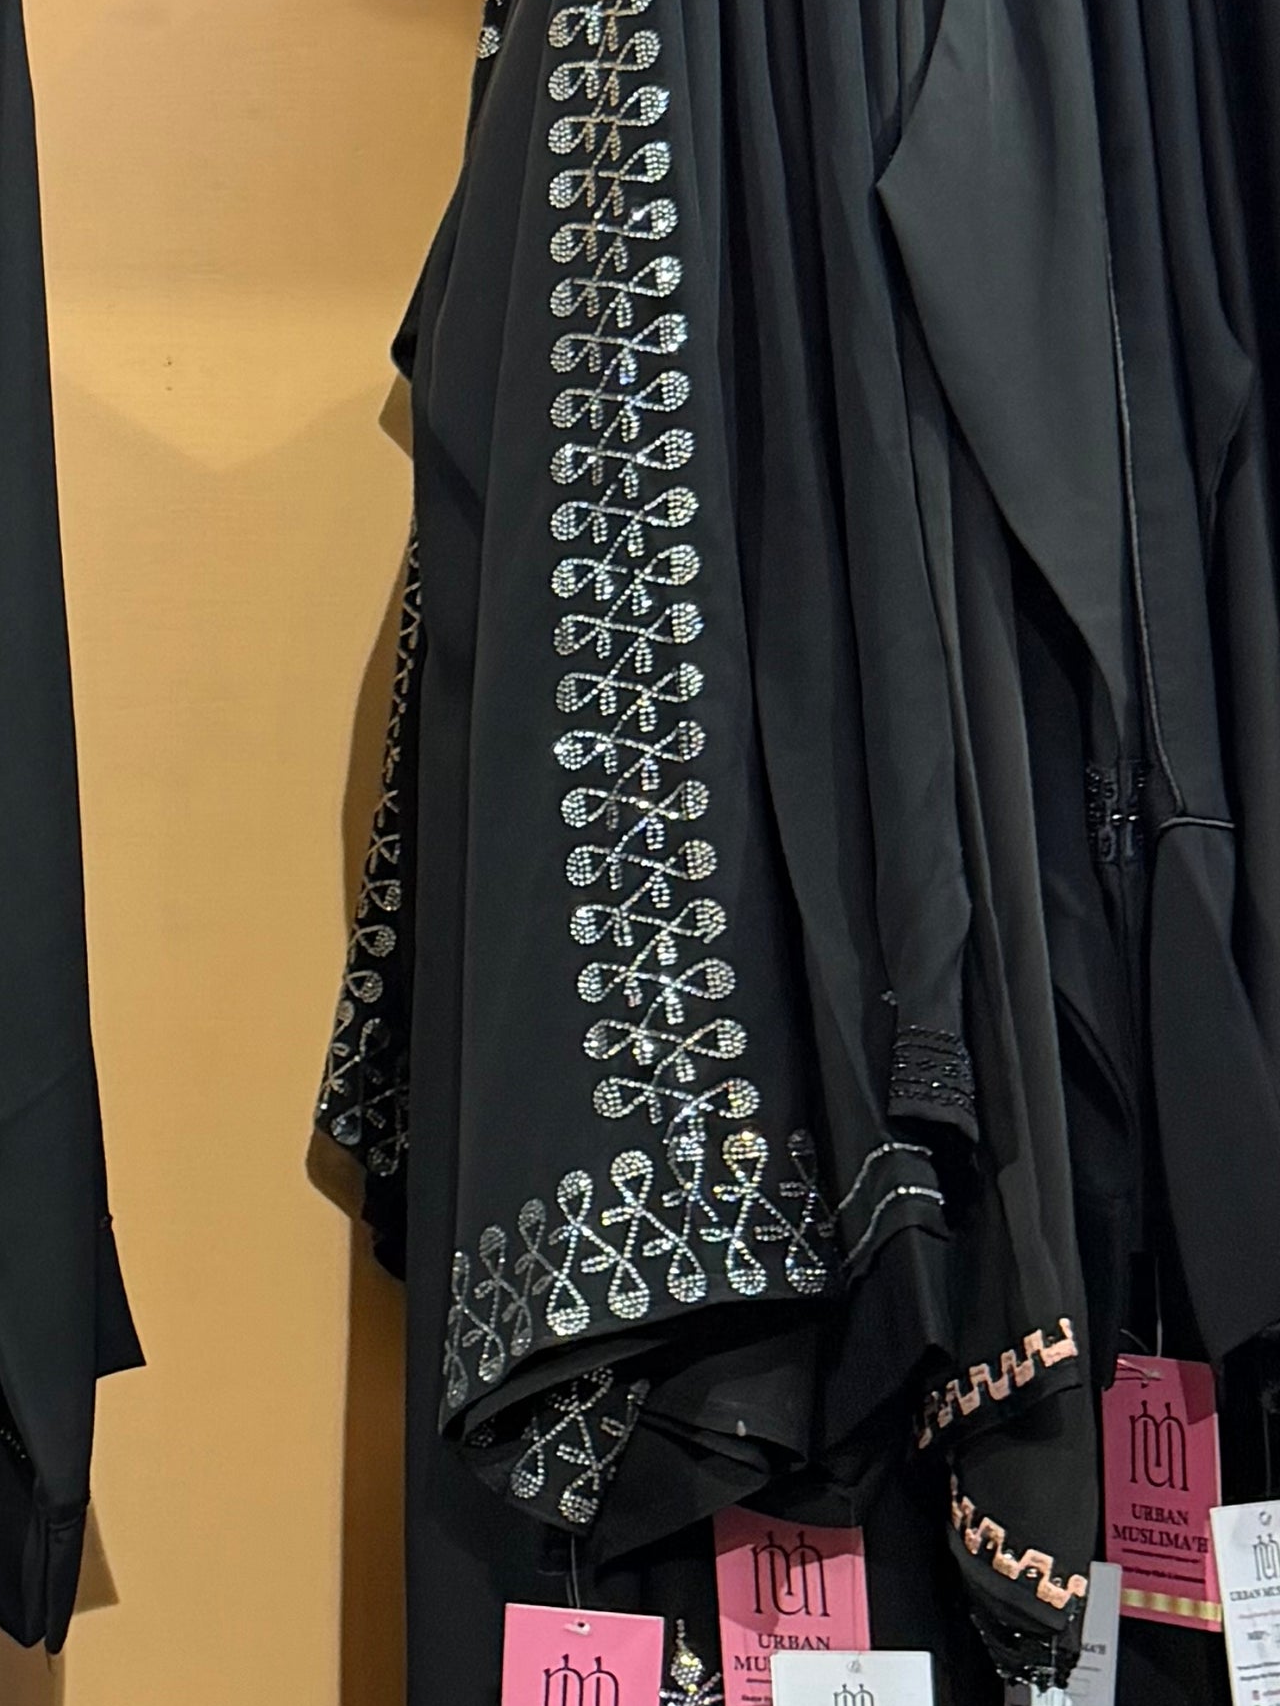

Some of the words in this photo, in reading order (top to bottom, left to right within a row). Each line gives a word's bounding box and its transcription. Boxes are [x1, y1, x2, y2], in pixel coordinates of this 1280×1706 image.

[1131, 1503, 1189, 1526] URBAN
[1112, 1523, 1209, 1554] MUSLIMA'H
[756, 1632, 831, 1651] URBAN
